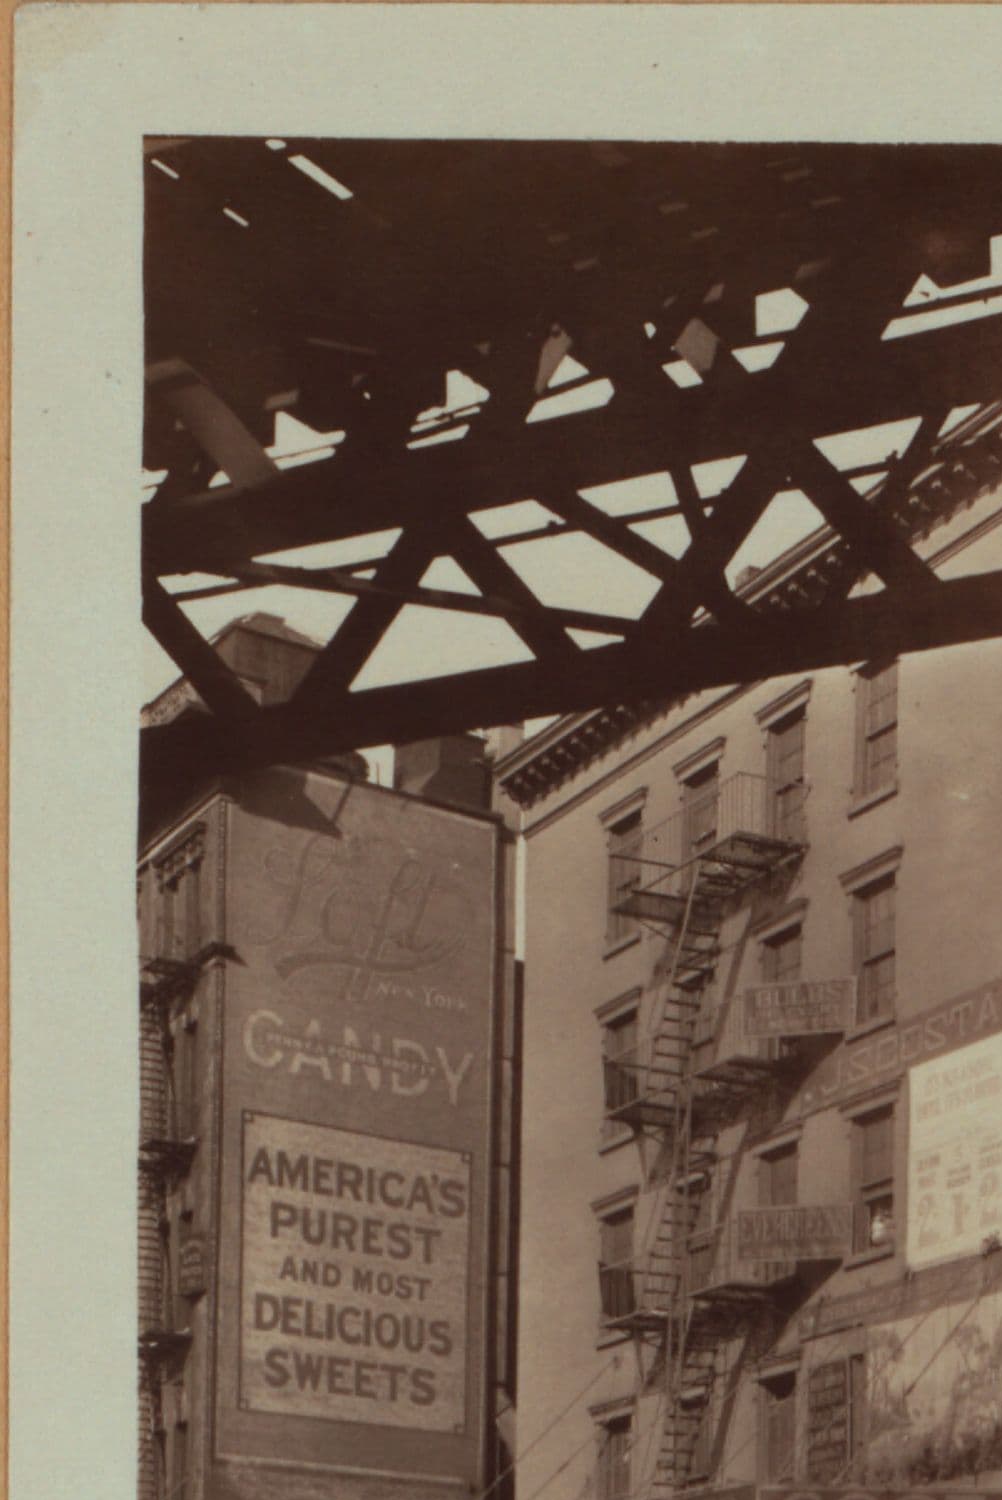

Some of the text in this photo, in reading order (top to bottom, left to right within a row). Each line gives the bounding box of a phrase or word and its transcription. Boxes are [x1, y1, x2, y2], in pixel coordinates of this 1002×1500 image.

[243, 1008, 474, 1106] CANDY
[875, 992, 999, 1073] COSTA
[247, 1145, 466, 1217] AMERICA'S
[269, 1200, 442, 1264] PUREST
[279, 1255, 432, 1301] AND MOST
[254, 1292, 453, 1356] DELICIOUS
[263, 1347, 436, 1407] SWEETS
